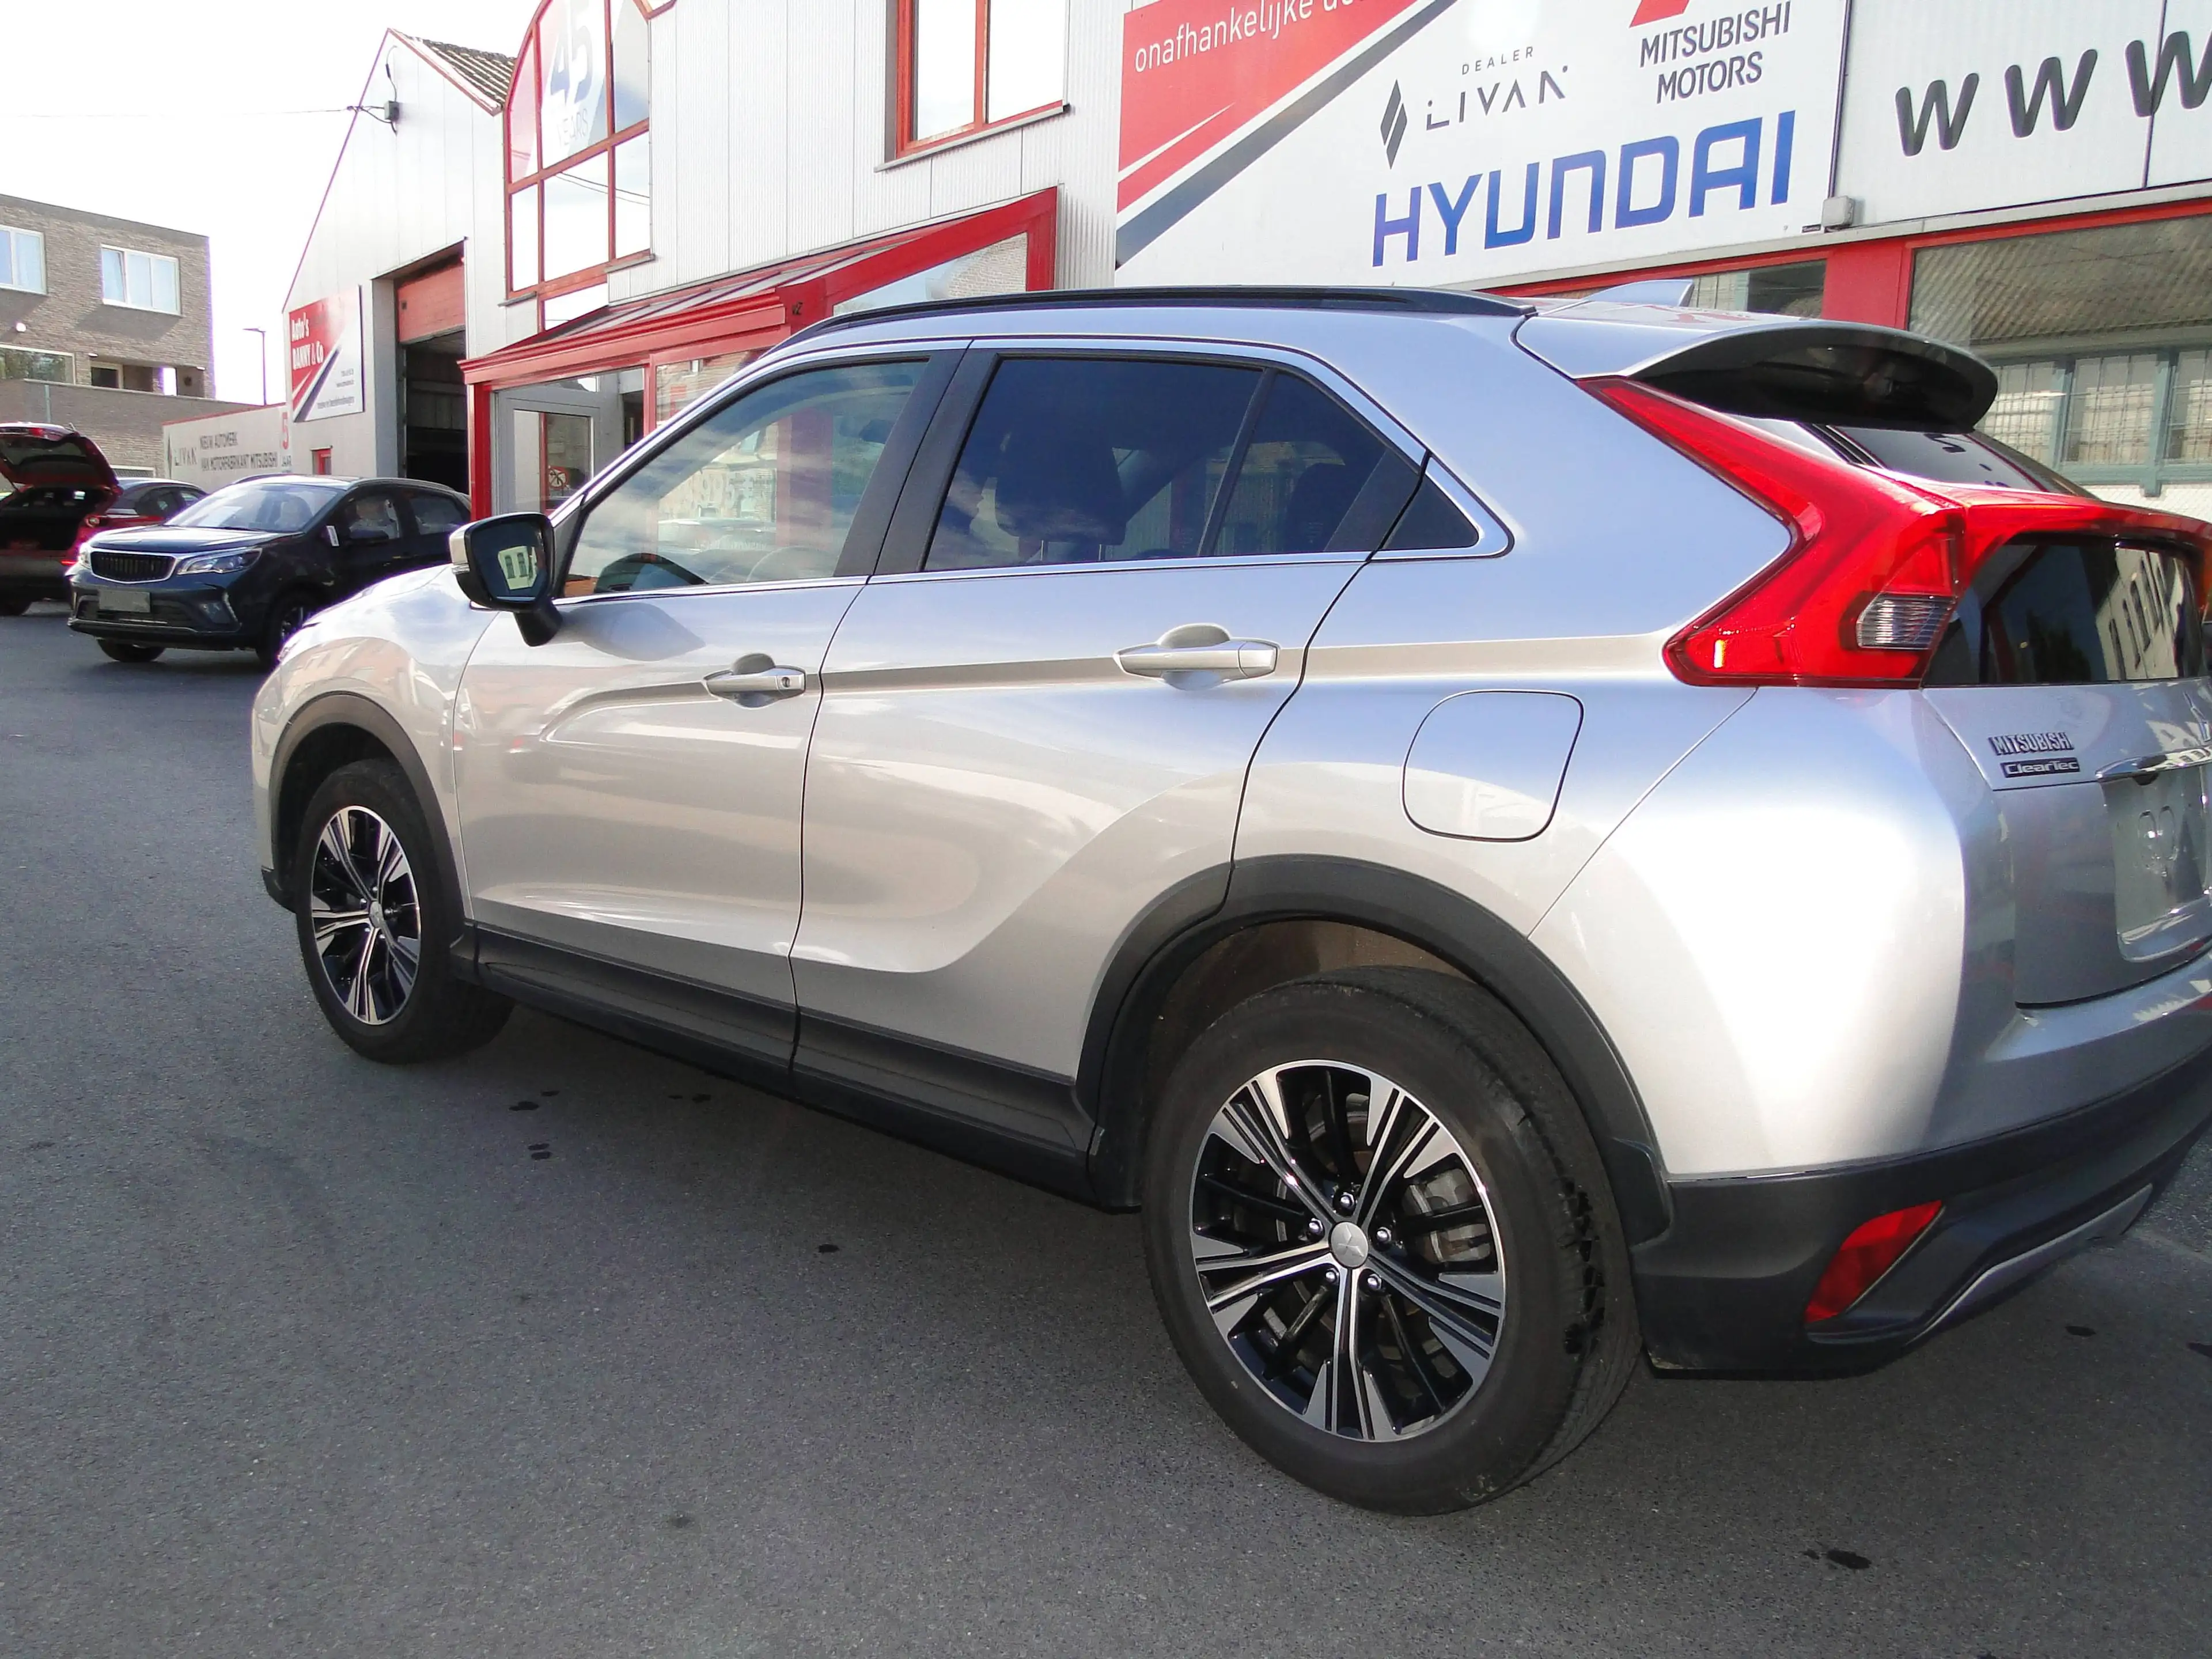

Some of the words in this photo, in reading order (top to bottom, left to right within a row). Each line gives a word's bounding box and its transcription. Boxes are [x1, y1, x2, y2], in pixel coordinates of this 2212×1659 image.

[551, 0, 592, 107] 45
[1135, 0, 1313, 73] onafhankelijke
[1462, 46, 1533, 75] DEALER
[1640, 3, 1790, 67] MITSUBISHI
[1657, 52, 1763, 104] MOTORS
[1372, 110, 1796, 267] HYUNDAI
[292, 312, 309, 342] Auto's
[293, 344, 311, 370] DANNY
[2004, 760, 2078, 775] ClearTec
